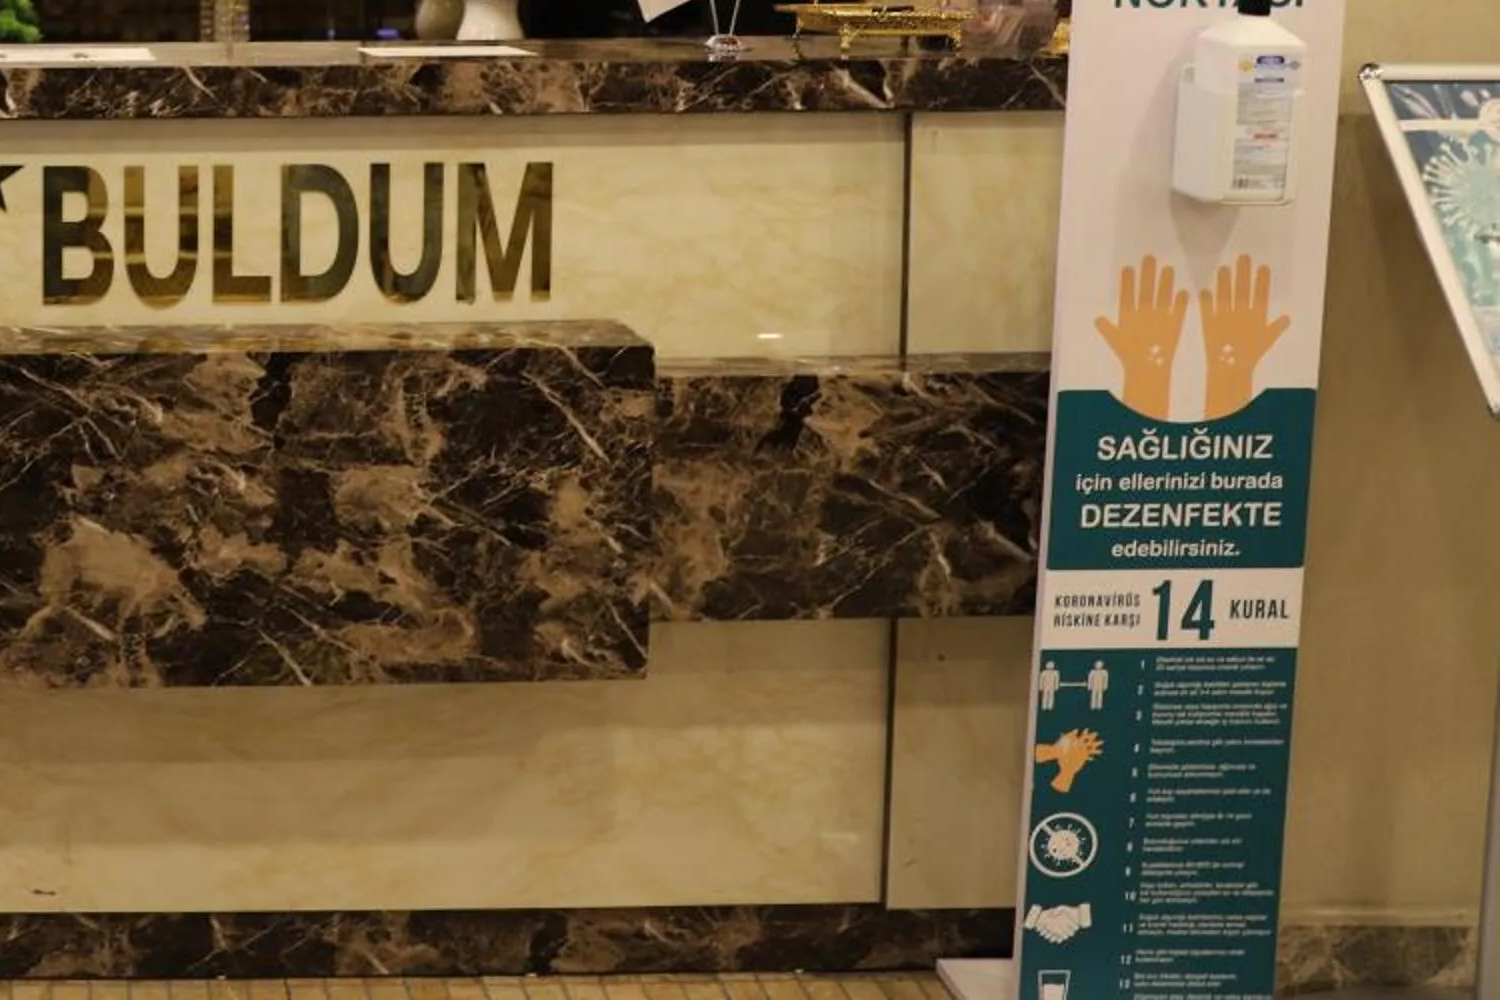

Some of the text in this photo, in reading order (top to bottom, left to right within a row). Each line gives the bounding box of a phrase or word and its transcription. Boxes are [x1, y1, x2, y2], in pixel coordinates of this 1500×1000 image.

[41, 161, 554, 307] BULDUM
[1097, 428, 1274, 460] SAĞLIĞINIZ
[1076, 472, 1283, 494] için ellerinizi burada
[1080, 502, 1282, 528] DEZENFEKTE
[1111, 540, 1241, 558] edebilirsiniz.
[1152, 579, 1215, 641] 14
[1229, 599, 1289, 620] KURAL
